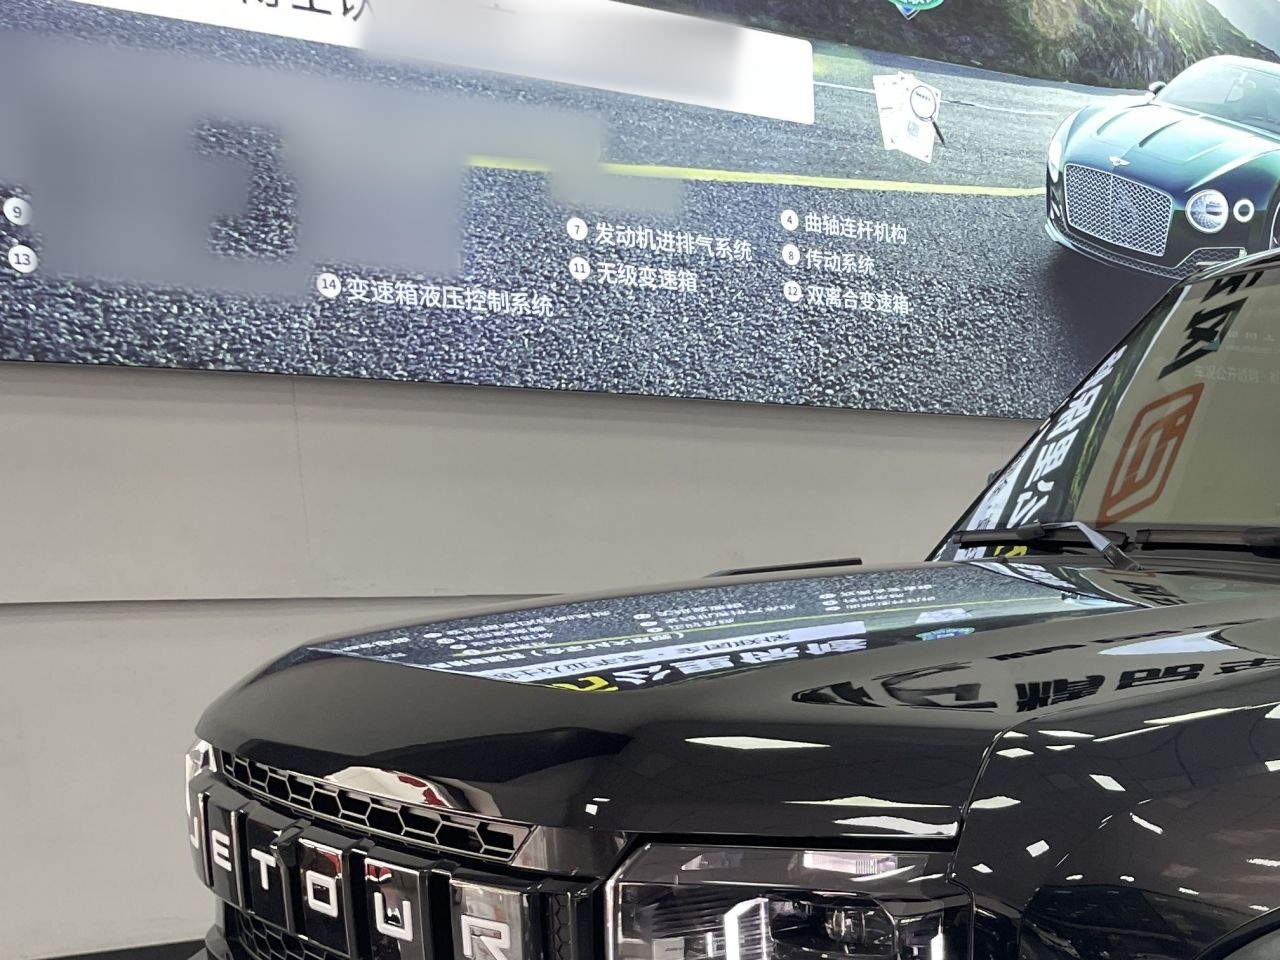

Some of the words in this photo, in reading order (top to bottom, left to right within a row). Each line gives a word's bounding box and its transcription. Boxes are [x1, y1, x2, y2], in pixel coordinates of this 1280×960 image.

[596, 222, 753, 261] 发动机进排气系统
[804, 212, 907, 245] 曲轴连杆机构
[597, 262, 698, 293] 无级变速箱
[805, 248, 876, 276] 传动系统
[347, 278, 554, 317] 变速箱液压控制系统
[807, 285, 909, 314] 双离合变速箱
